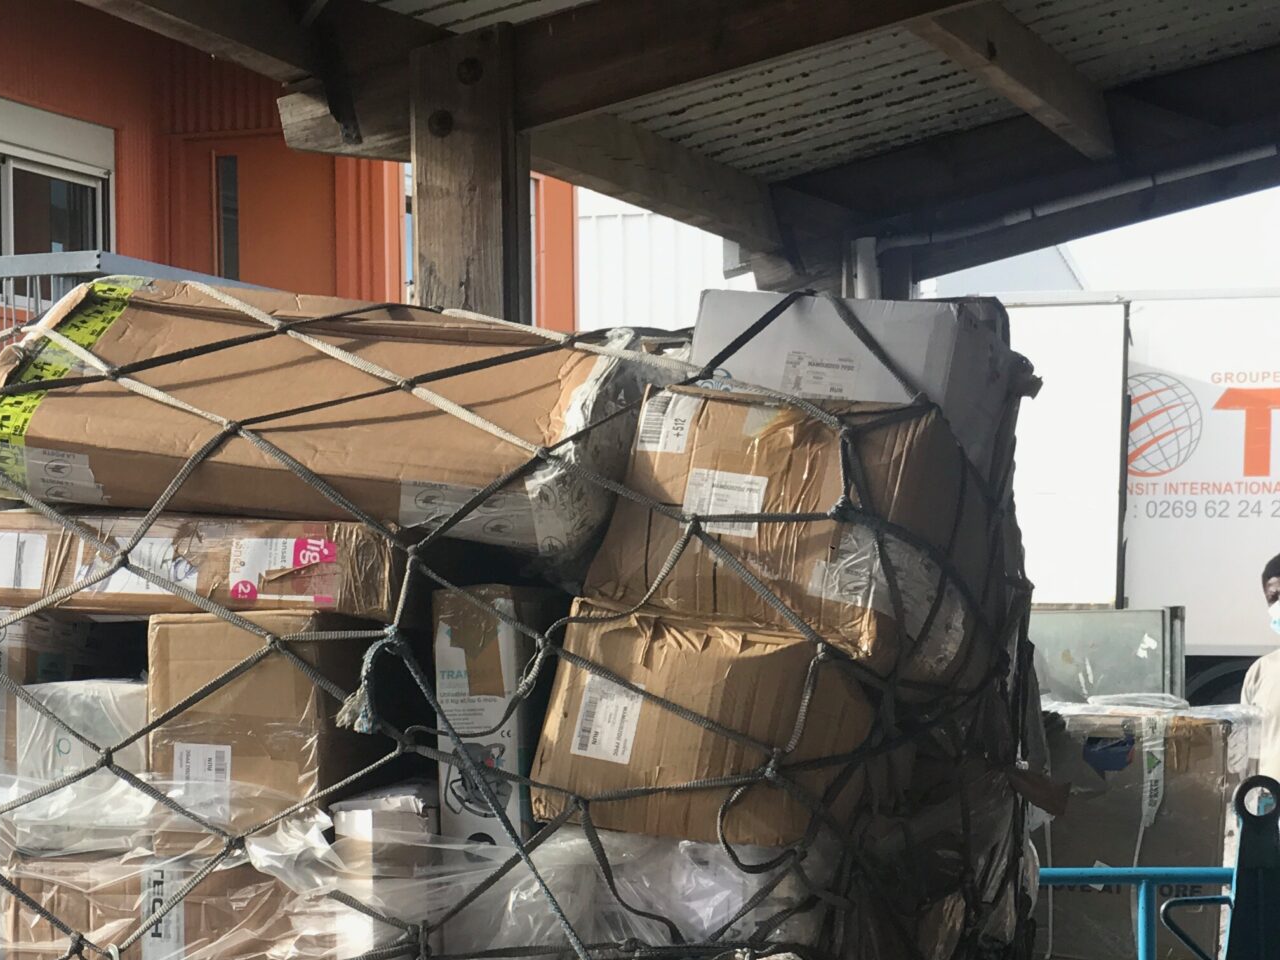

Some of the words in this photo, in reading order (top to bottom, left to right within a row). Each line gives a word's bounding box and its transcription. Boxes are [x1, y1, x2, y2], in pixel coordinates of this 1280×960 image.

[1211, 371, 1280, 384] GROUPE
[672, 417, 687, 438] +512
[1145, 499, 1197, 519] 0269
[1204, 499, 1230, 518] 62
[1237, 499, 1263, 518] 24
[237, 583, 251, 593] 2
[591, 730, 600, 745] RUN
